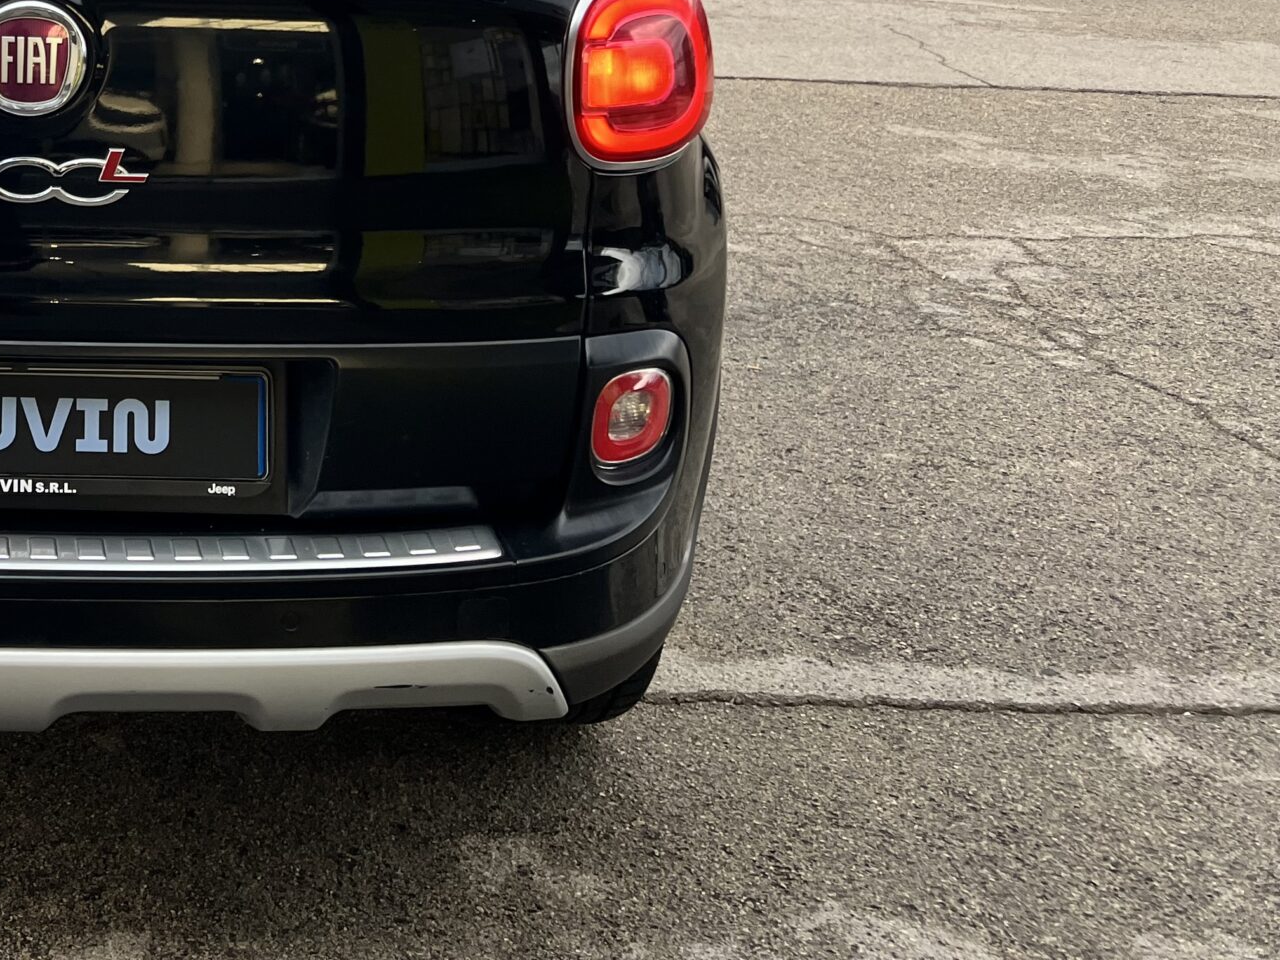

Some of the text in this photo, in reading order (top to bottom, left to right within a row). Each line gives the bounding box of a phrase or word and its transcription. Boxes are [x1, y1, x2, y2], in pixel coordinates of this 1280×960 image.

[1, 36, 63, 84] FIAT
[35, 481, 77, 493] S.R.L.
[207, 483, 236, 496] Jeep
